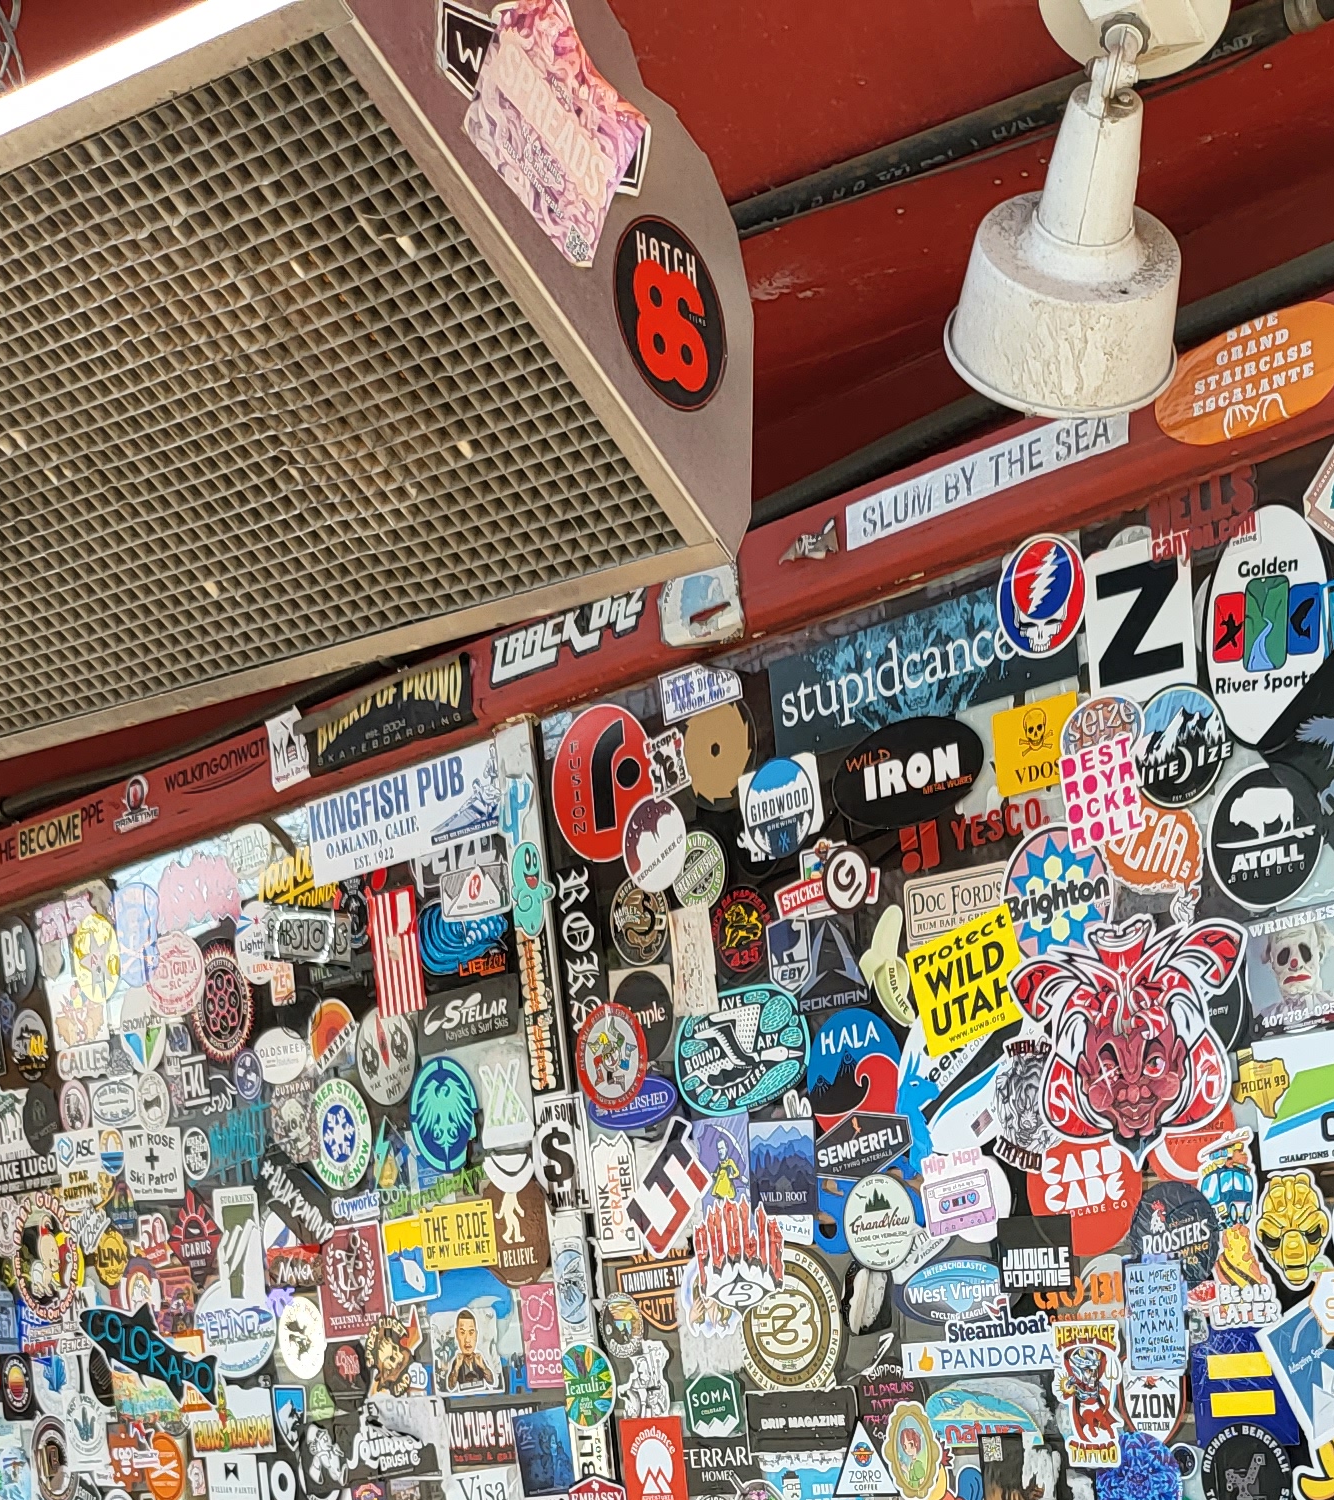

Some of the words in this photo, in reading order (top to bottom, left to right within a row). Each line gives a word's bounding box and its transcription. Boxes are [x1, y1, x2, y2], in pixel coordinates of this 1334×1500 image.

[1216, 326, 1289, 368] GRAND
[1226, 312, 1279, 344] SAVE
[1194, 341, 1313, 395] STAIRCASE
[1191, 364, 1315, 418] ESCALANTE
[861, 481, 935, 539] SLUM
[943, 468, 976, 505] BY
[990, 445, 1045, 488] THE
[1055, 418, 1112, 461] SEA
[1237, 556, 1299, 578] Golden
[779, 619, 1011, 728] stupidcance
[845, 750, 892, 772] WILD
[864, 744, 961, 801] IRON
[310, 775, 412, 839] KINGFISH
[418, 758, 465, 801] PUB
[1008, 875, 1111, 921] Brighton
[912, 912, 1008, 972] Protect
[925, 949, 1005, 995] WILD
[933, 991, 1013, 1035] UTAH
[948, 1014, 1006, 1044] www.suwa.org
[818, 1024, 881, 1056] HALA
[816, 1125, 906, 1166] SEMPERFLI
[1279, 1150, 1329, 1164] CHAMPIONS
[425, 1214, 453, 1245] THE
[456, 1206, 489, 1240] RIDE
[1141, 1220, 1211, 1256] ROOSTERS
[947, 1312, 1047, 1344] Steamboat
[86, 1308, 215, 1397] COLORADO
[939, 1342, 1053, 1370] PANDORA
[691, 1386, 732, 1408] SOMA
[1129, 1392, 1176, 1421] ZION
